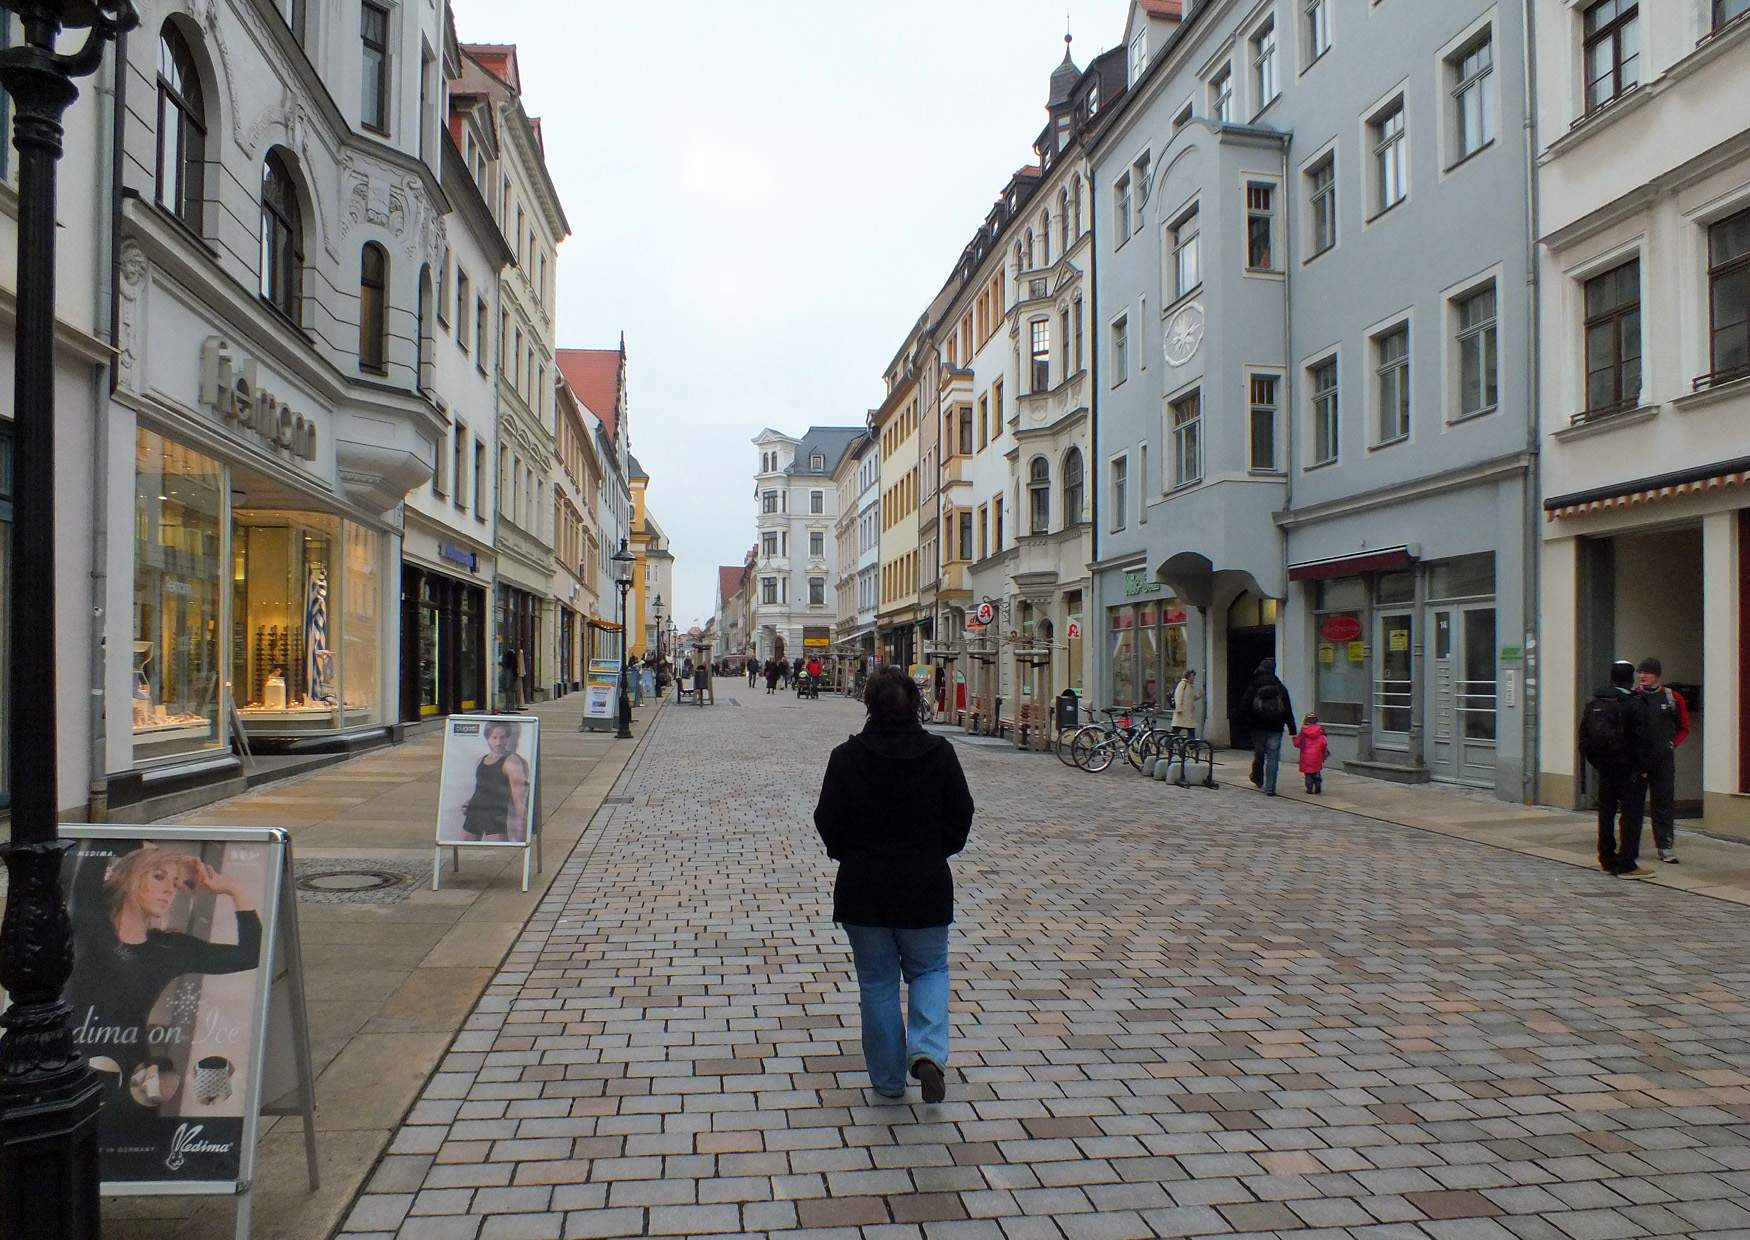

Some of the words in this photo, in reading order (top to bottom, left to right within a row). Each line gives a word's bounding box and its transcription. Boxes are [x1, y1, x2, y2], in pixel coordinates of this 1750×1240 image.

[200, 335, 317, 462] Fielmann
[72, 1005, 139, 1045] dima
[148, 1022, 183, 1045] on
[192, 1009, 240, 1045] Ice
